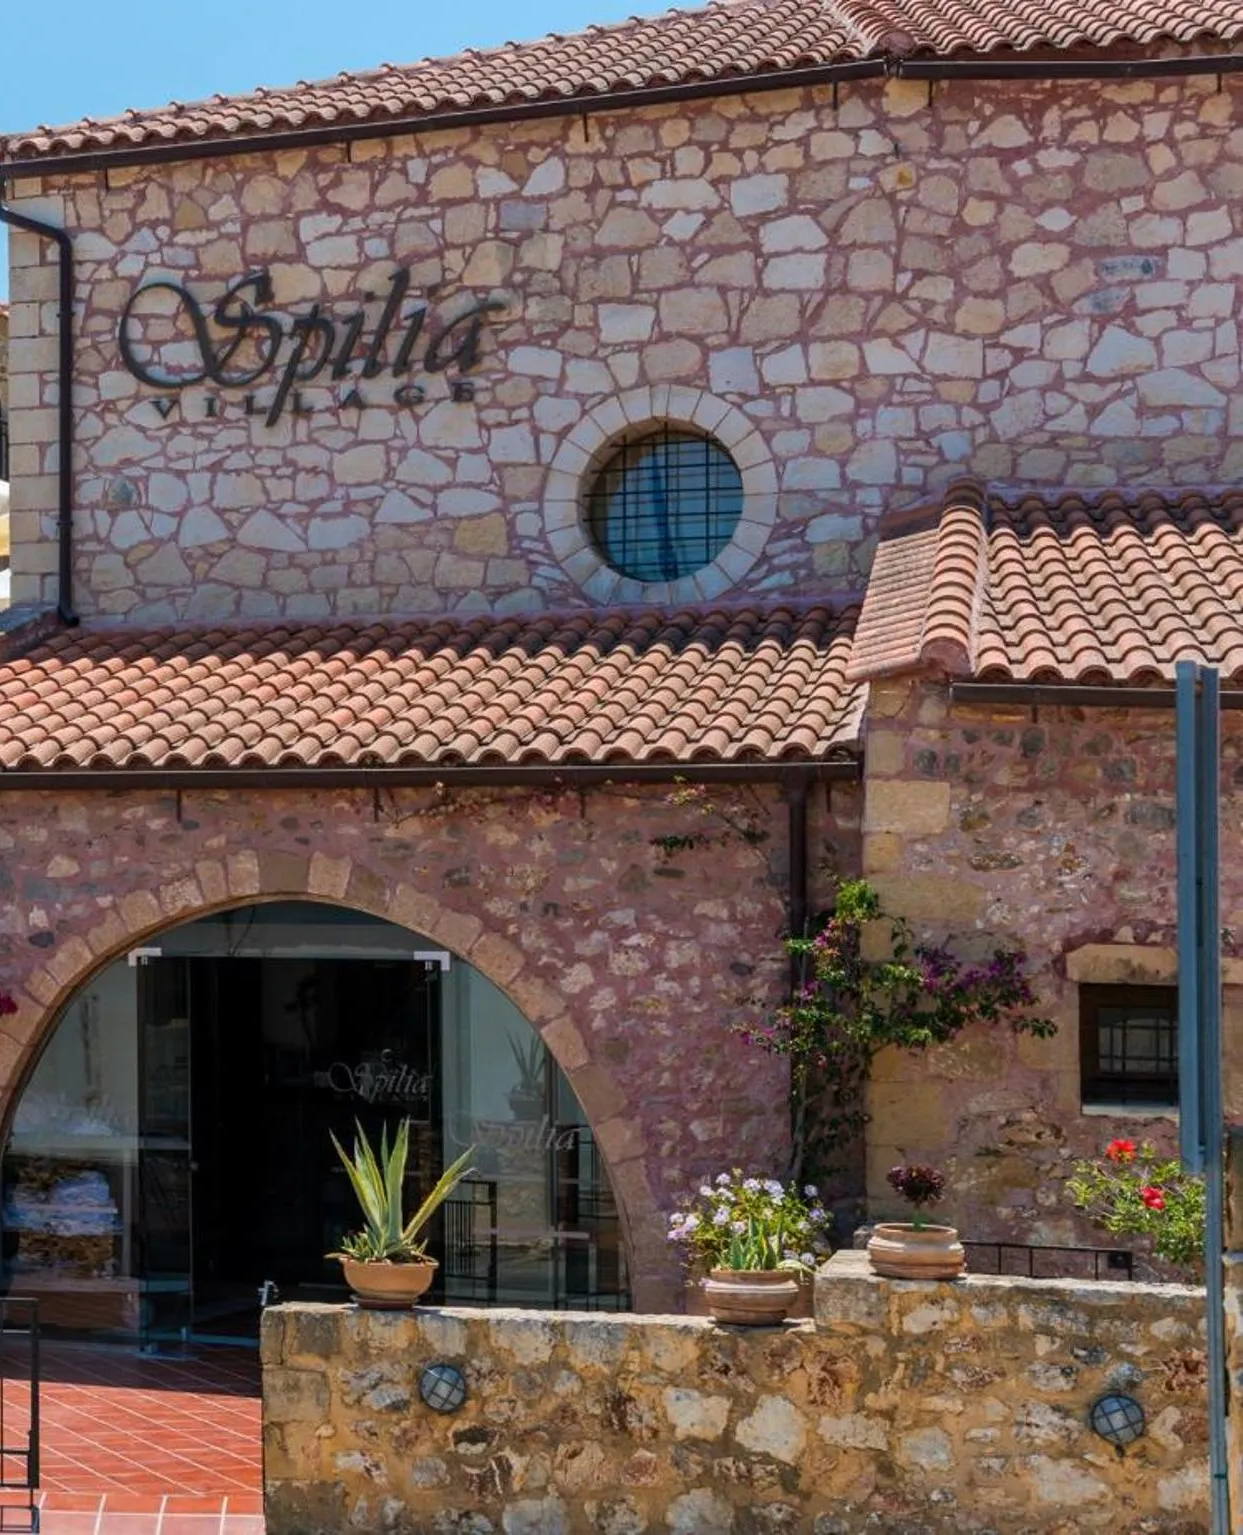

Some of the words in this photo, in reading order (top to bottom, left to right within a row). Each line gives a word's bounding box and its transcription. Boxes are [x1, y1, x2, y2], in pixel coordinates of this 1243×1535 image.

[119, 266, 506, 428] Spilia
[151, 381, 474, 418] VILLAGE
[328, 1062, 433, 1103] Spilia
